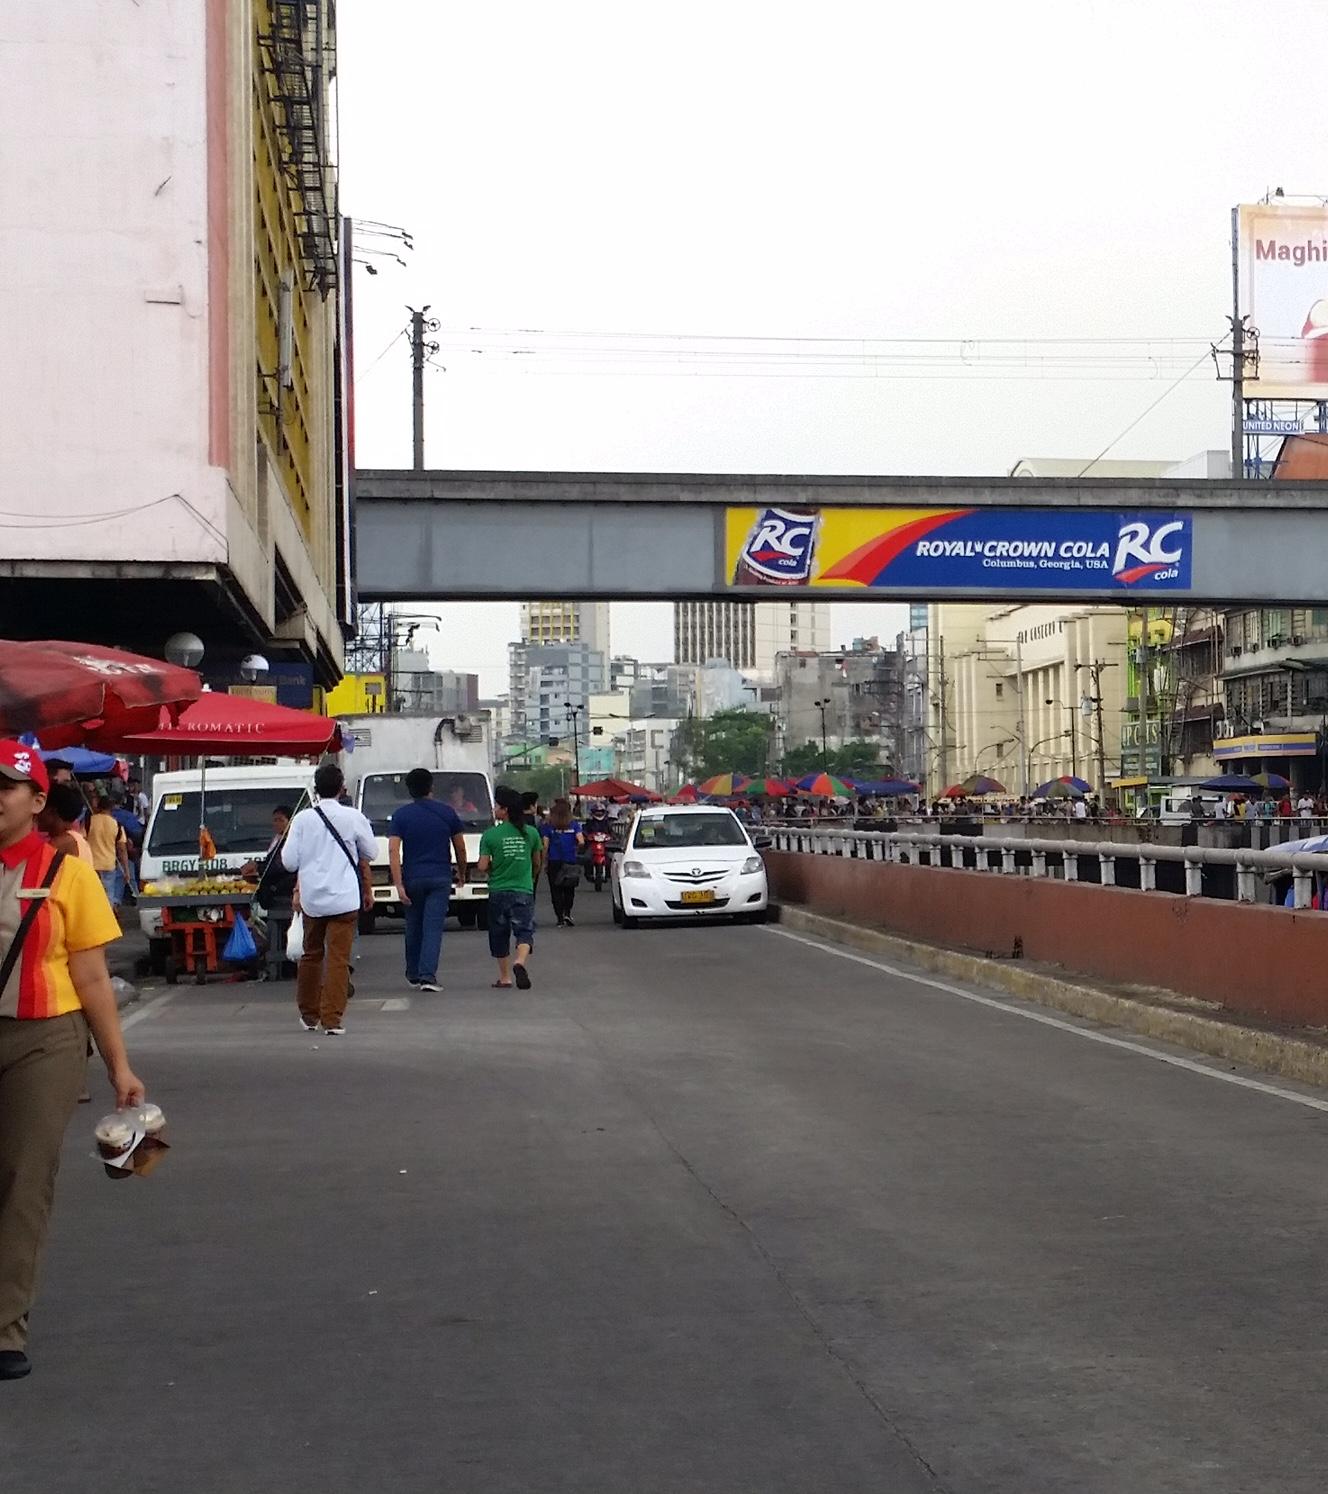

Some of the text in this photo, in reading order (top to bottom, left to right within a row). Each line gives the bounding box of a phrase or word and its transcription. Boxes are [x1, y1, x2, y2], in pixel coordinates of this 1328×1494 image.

[1242, 420, 1300, 431] UNITED NEON
[750, 519, 811, 557] RC
[1059, 541, 1110, 558] COLA
[1112, 520, 1185, 576] RC
[778, 558, 798, 567] cola
[982, 558, 1110, 571] Columbus, Georgia, USA
[1154, 567, 1179, 581] cola
[162, 859, 196, 873] BRGY
